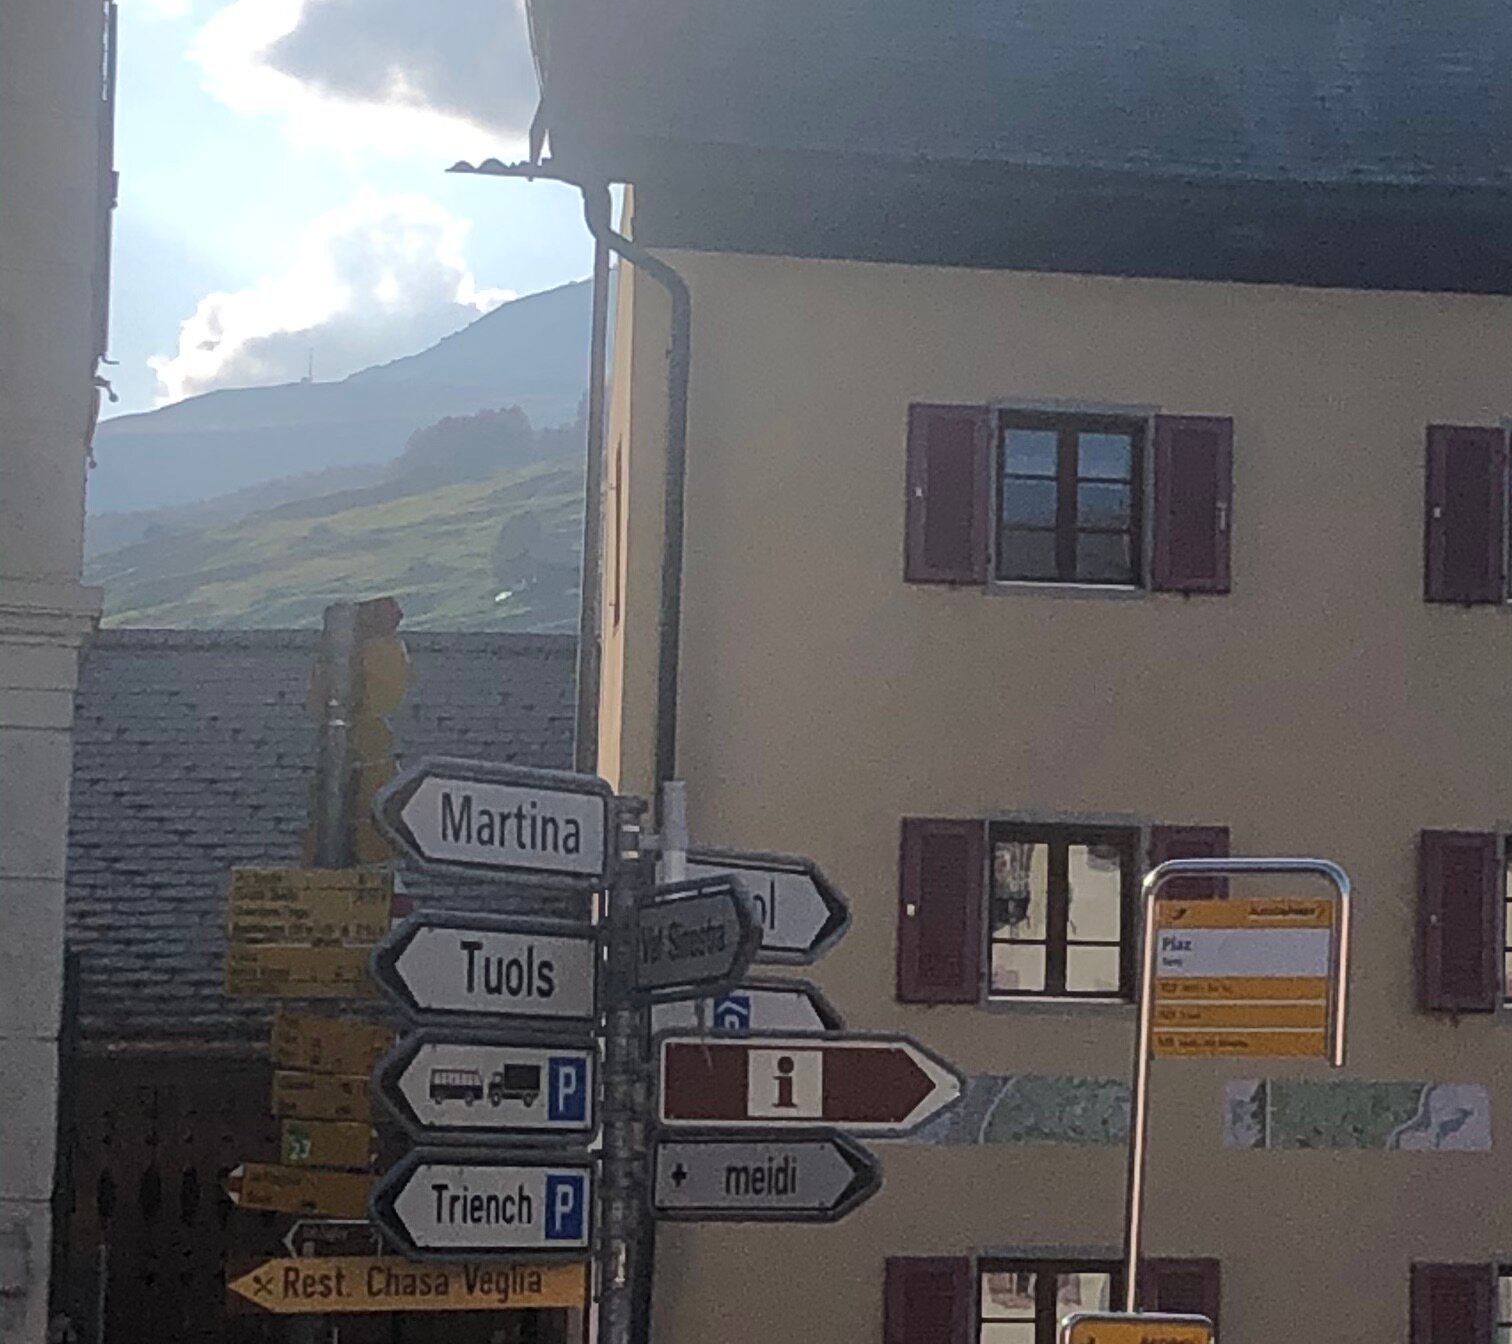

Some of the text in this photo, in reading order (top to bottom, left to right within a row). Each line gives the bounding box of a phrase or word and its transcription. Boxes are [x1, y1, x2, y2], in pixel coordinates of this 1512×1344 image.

[441, 791, 581, 854] Martina
[1162, 936, 1192, 952] Plaz
[460, 941, 556, 998] Tuols
[558, 1066, 577, 1114] P
[724, 1155, 798, 1195] meidi
[431, 1183, 575, 1233] Triench P
[282, 1263, 544, 1303] Rest. Chasa Veglia
